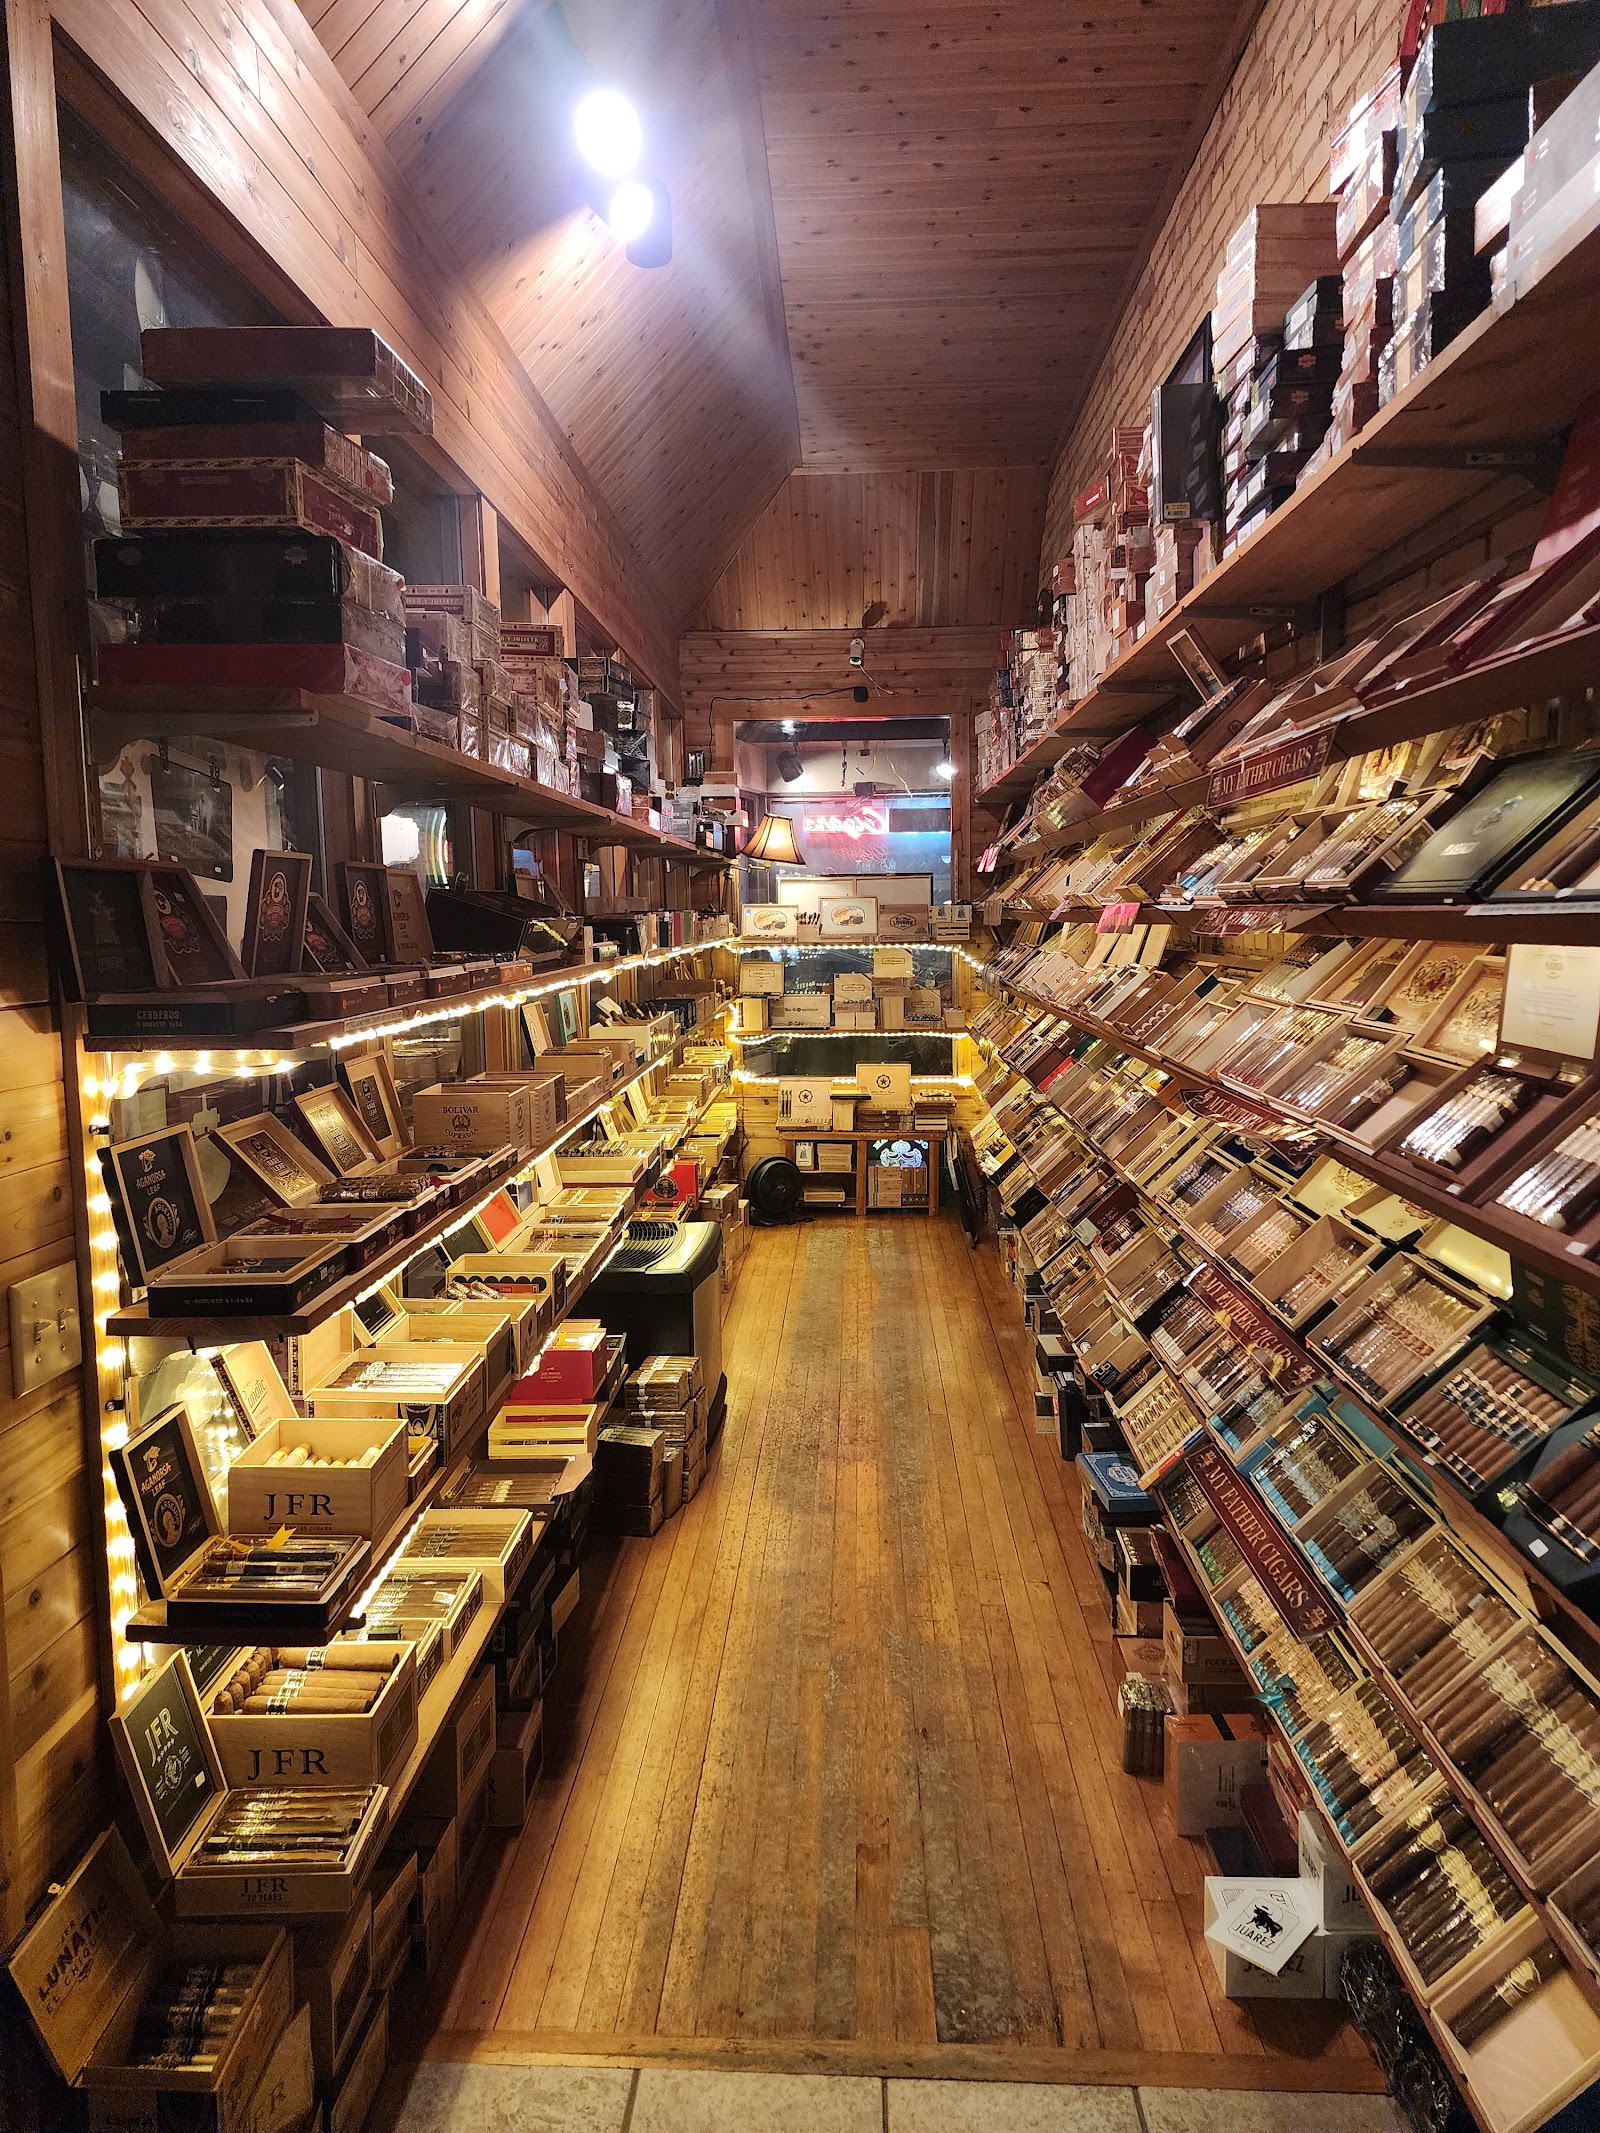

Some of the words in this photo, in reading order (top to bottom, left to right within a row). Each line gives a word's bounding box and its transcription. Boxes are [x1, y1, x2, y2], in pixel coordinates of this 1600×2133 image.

[1221, 774, 1237, 796] MY
[1236, 760, 1273, 791] FATHER
[1272, 744, 1313, 779] CIGARS
[137, 1010, 180, 1020] CERBERUS
[441, 1106, 480, 1114] BOLIVAR
[444, 1128, 479, 1140] COFRADIA
[136, 1169, 167, 1190] AGANORSA
[146, 1183, 161, 1196] LEAF
[1203, 1276, 1227, 1297] MY
[1214, 1290, 1260, 1334] FATHER
[140, 1461, 172, 1494] AGANORSA
[151, 1478, 167, 1497] LEAF
[263, 1493, 336, 1521] JFR
[1204, 1464, 1232, 1492] MY
[1219, 1486, 1268, 1549] FATHER
[1257, 1542, 1310, 1610] CIGARS
[144, 1707, 180, 1768] JFR
[247, 1749, 330, 1782] JFR
[240, 1877, 289, 1896] JFR
[37, 1895, 108, 2003] LUNATIC
[1233, 1924, 1276, 1949] JUAREZ
